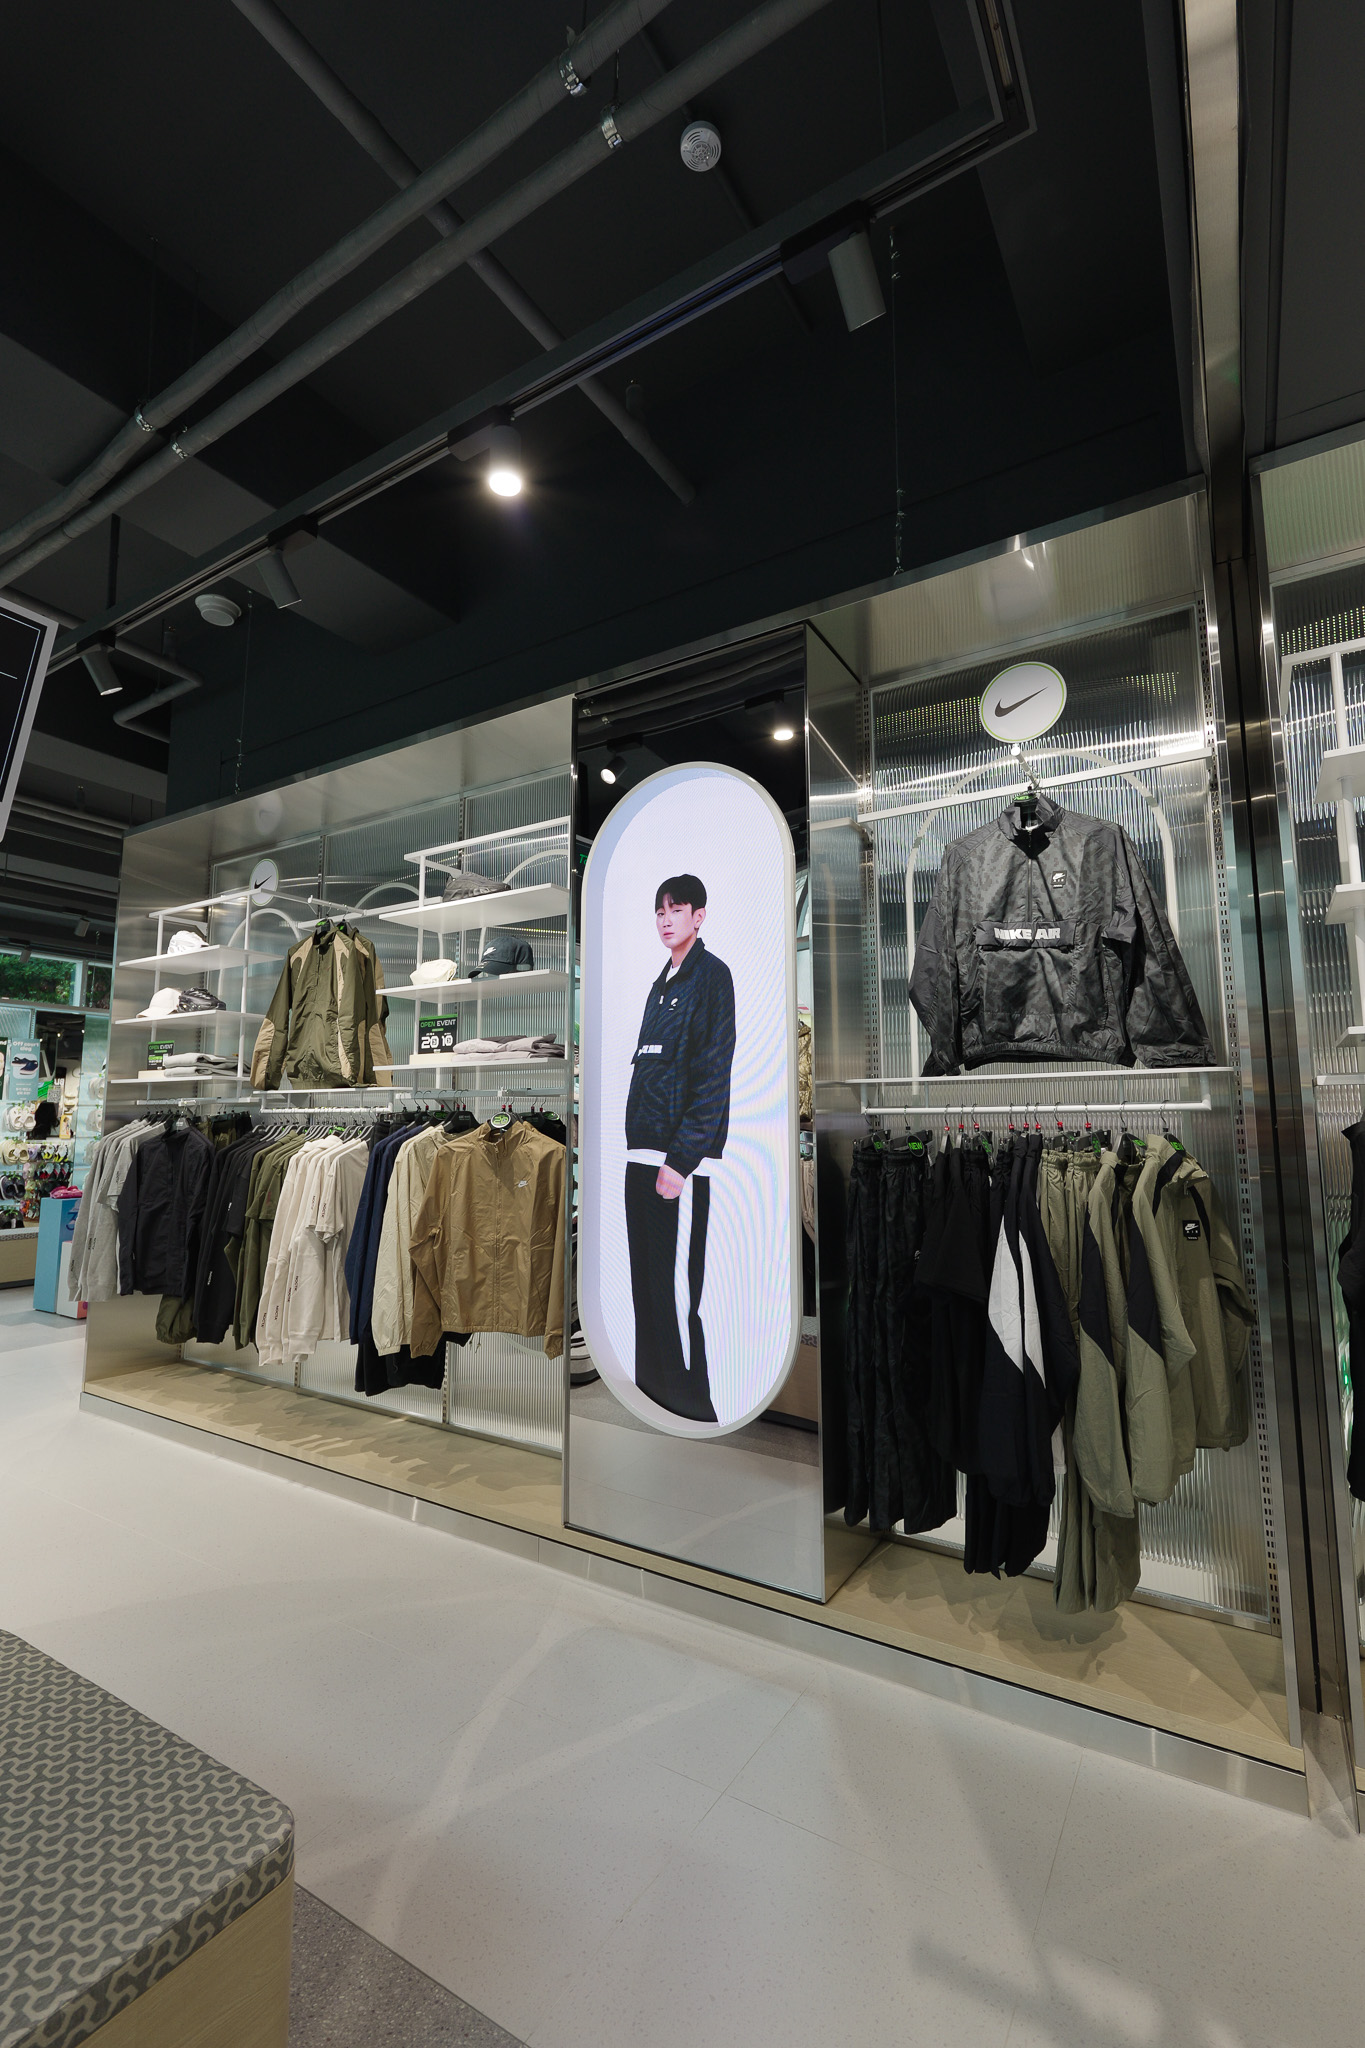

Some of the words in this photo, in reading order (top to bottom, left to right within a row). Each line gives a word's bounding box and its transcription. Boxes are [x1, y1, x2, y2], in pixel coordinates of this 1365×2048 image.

[994, 927, 1032, 940] NIKE
[1034, 927, 1061, 940] AIR
[436, 1019, 456, 1027] EVENT
[908, 1141, 923, 1151] NEW
